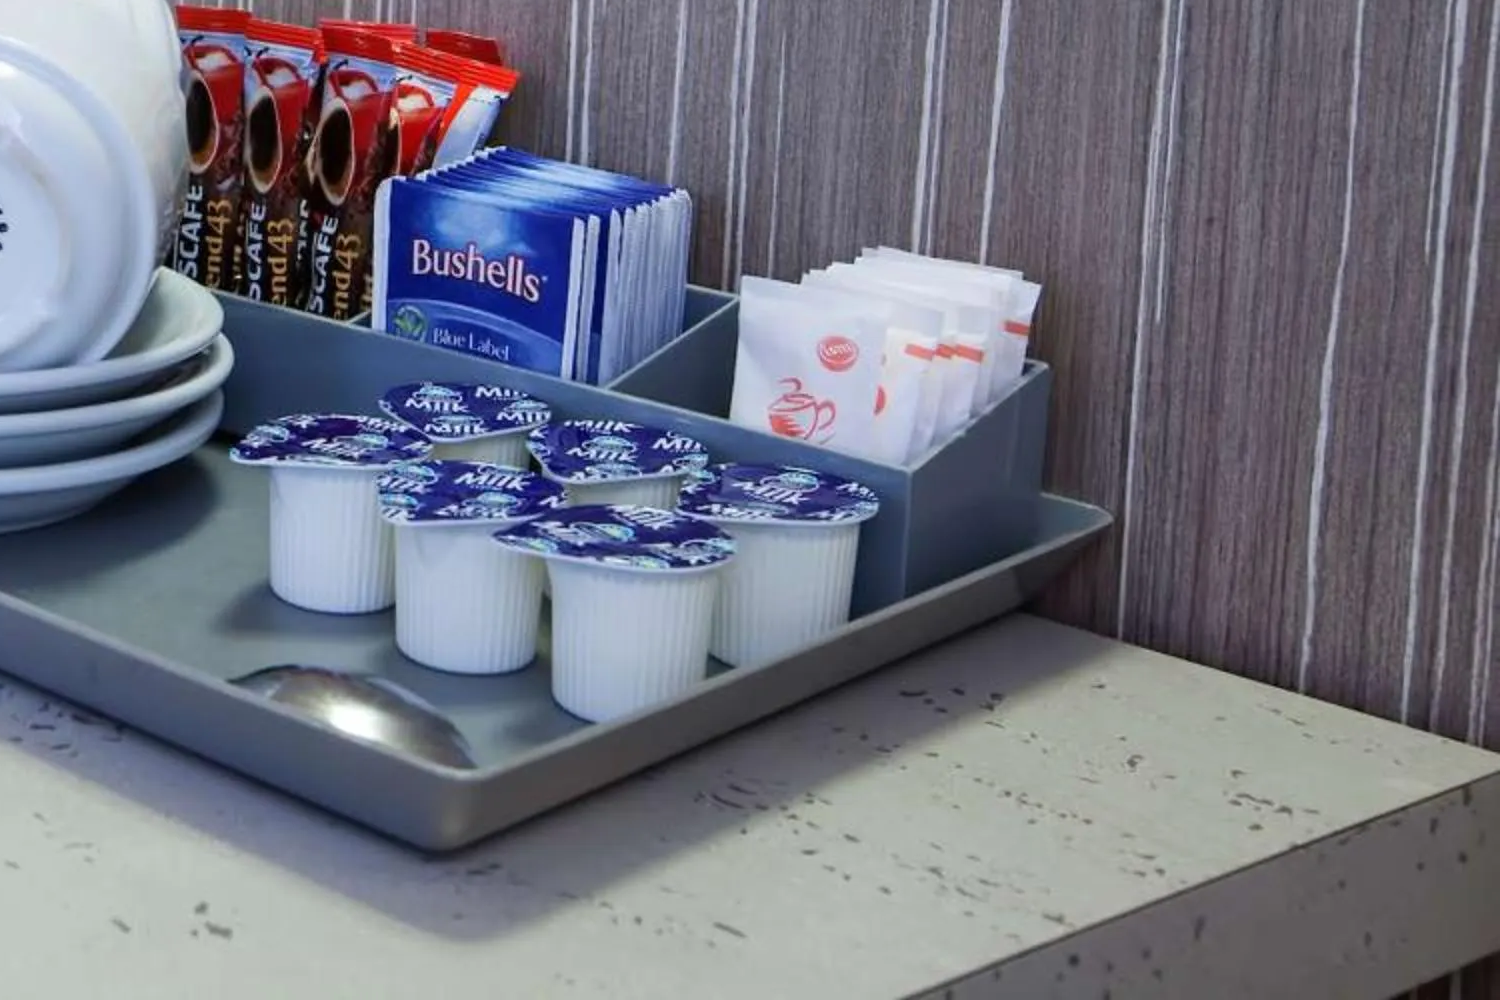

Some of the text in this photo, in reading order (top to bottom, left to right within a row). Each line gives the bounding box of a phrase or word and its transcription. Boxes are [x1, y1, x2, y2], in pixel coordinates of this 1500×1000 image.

[179, 185, 203, 278] SCAFE
[247, 203, 267, 300] SCAFE
[309, 215, 339, 313] SCAFE
[412, 239, 540, 302] Bushells
[433, 327, 509, 361] Blue Label
